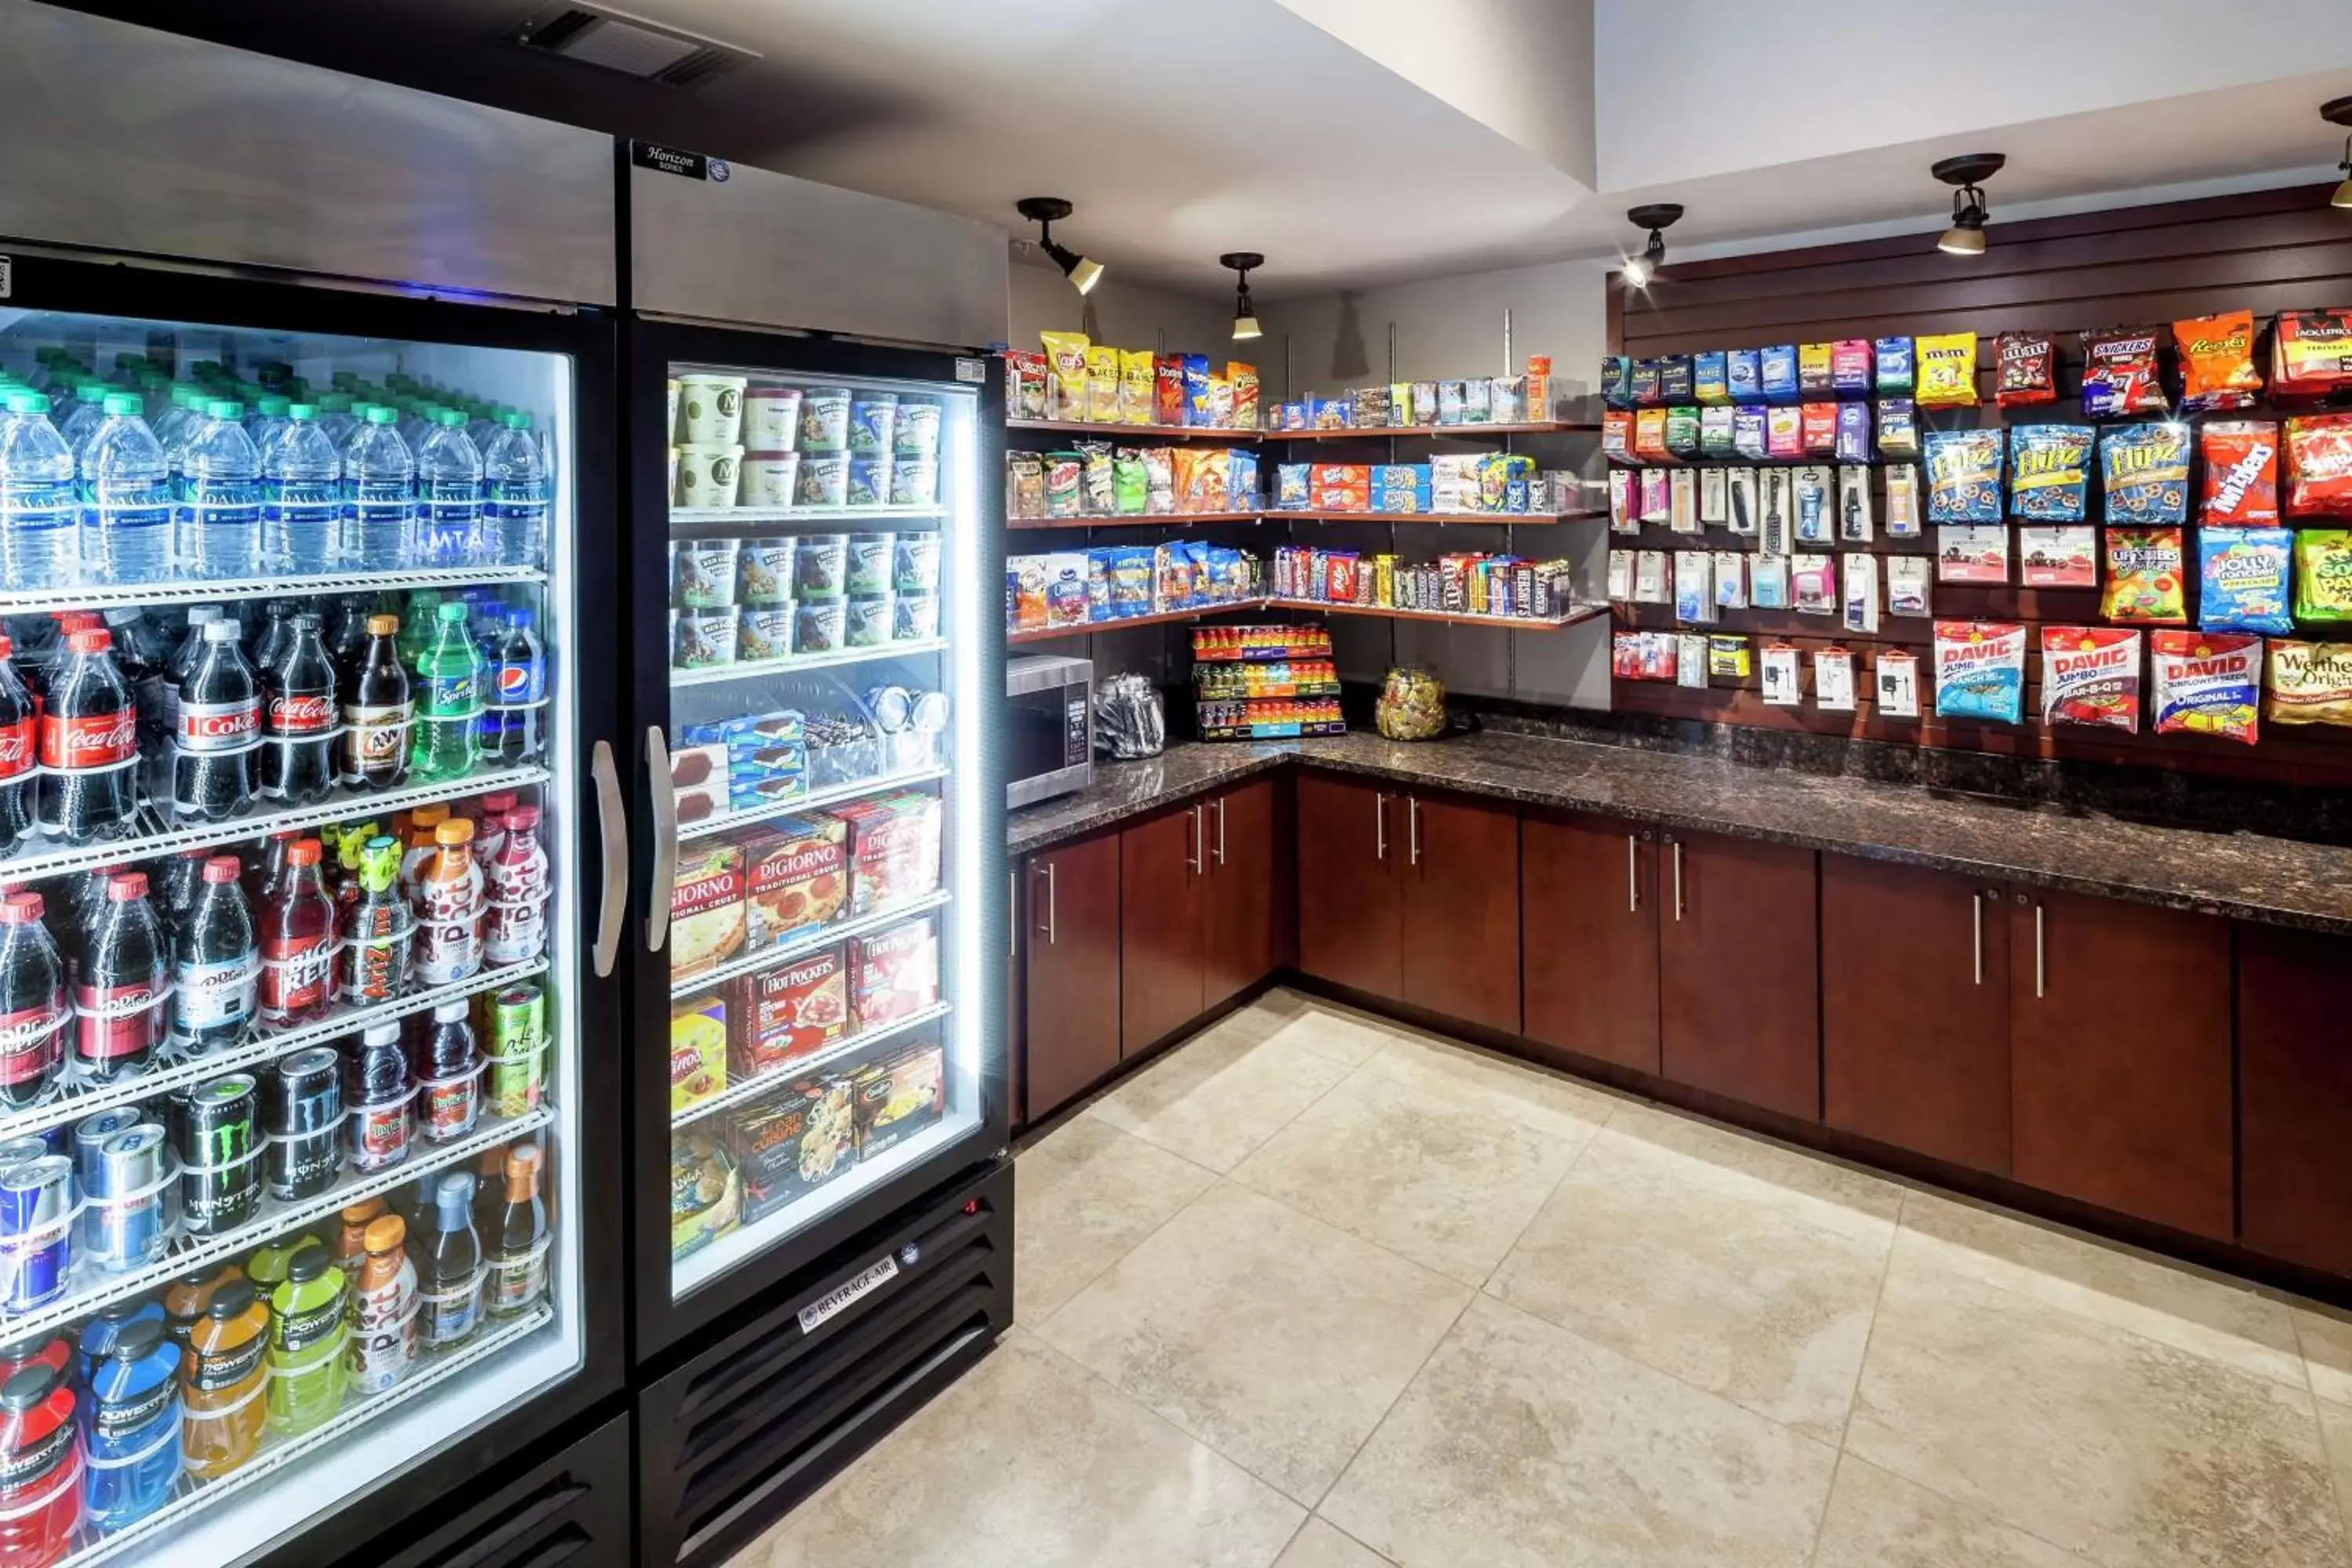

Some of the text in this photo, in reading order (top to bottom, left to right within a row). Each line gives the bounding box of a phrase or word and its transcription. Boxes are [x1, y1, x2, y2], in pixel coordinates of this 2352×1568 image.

[647, 147, 695, 167] Horizon
[2096, 339, 2151, 356] SNICKERS
[2220, 555, 2275, 571] JOLLY
[2167, 657, 2247, 680] DAVID
[2278, 654, 2352, 675] Werthe
[2057, 670, 2097, 684] JUMBO
[2169, 673, 2248, 688] SUNFLOWER SEEDS
[2301, 670, 2352, 688] Origin
[440, 686, 477, 705] Sprite
[2176, 691, 2230, 706] ORIGINAL
[201, 712, 256, 735] Coke
[67, 720, 136, 750] Coca-Cola
[759, 845, 838, 880] DIGIORNO
[755, 863, 840, 893] TRADITIONAL CRUST
[671, 875, 734, 907] GIORNO
[671, 895, 737, 920] TIONAL CRUST
[769, 961, 833, 993] HOT POCKETS
[817, 1260, 892, 1315] BEVERAGE-AIR
